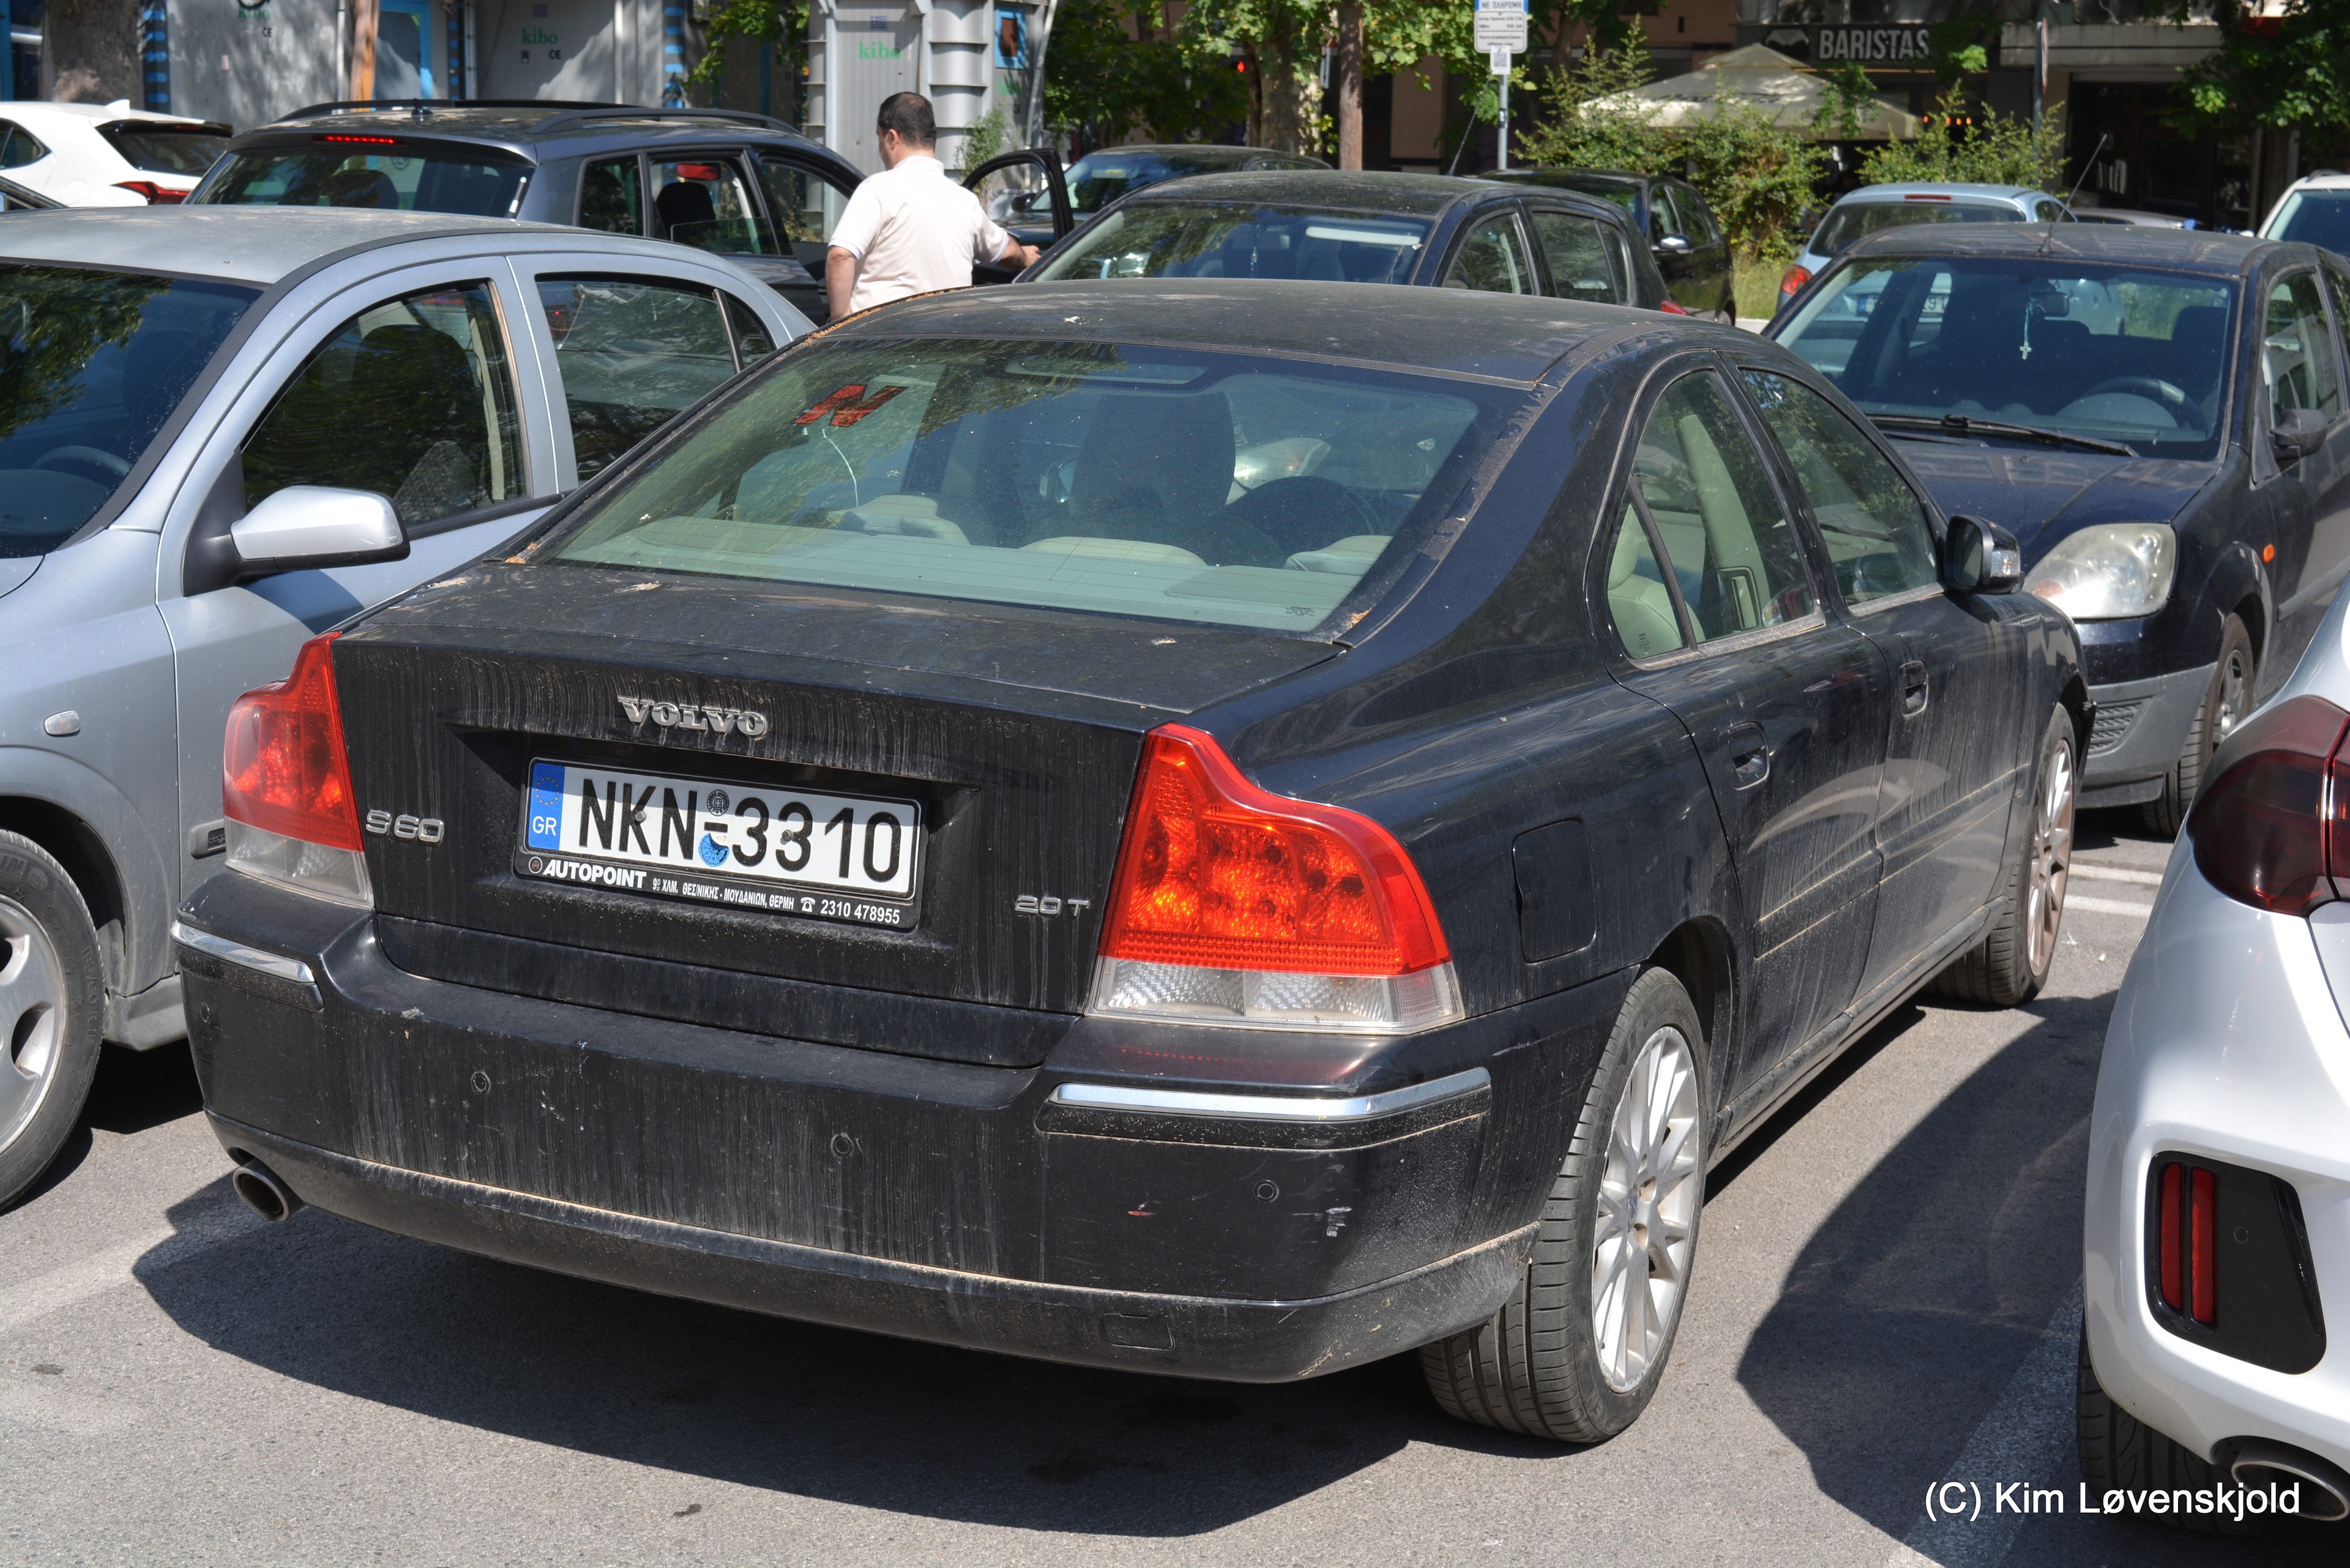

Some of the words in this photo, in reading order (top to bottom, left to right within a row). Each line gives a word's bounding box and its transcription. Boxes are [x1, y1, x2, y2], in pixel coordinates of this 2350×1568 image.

[522, 28, 558, 45] kibo
[858, 41, 901, 59] kibo
[1818, 29, 1930, 61] BARISTAS
[617, 696, 767, 736] VOLVO
[365, 810, 444, 843] S60
[532, 816, 557, 836] GR
[579, 778, 901, 883] NKN-3310
[542, 859, 647, 889] AUTOPOINT
[769, 895, 794, 910] ΘΕΡΜΗ
[820, 898, 851, 917] 2310
[854, 904, 900, 925] 478955
